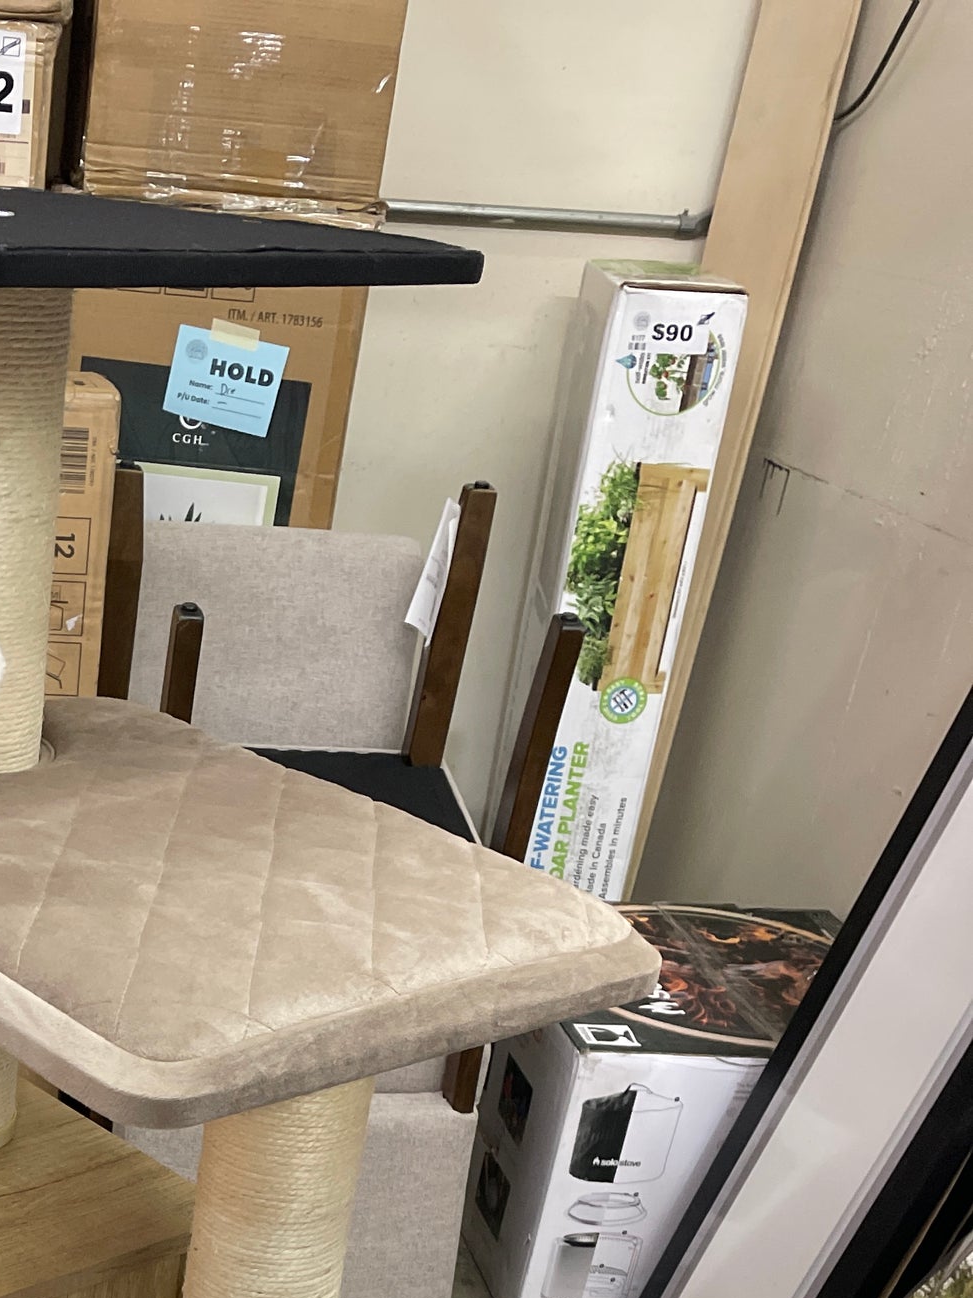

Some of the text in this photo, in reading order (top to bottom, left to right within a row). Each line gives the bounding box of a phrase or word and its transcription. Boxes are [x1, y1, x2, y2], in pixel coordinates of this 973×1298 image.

[228, 308, 247, 322] ITM.
[257, 312, 278, 325] ART.
[282, 313, 324, 328] 1783156
[209, 358, 275, 387] HOLD
[189, 379, 213, 391] Name:
[191, 395, 210, 405] Date:
[172, 432, 203, 446] CGH
[54, 533, 76, 559] 12
[557, 741, 590, 835] PLANTER
[581, 820, 593, 847] made
[588, 794, 600, 818] easy
[593, 823, 607, 859] Canada
[598, 797, 627, 900] Assembles in minutes
[590, 859, 599, 871] in
[600, 1158, 641, 1167] solo stove
